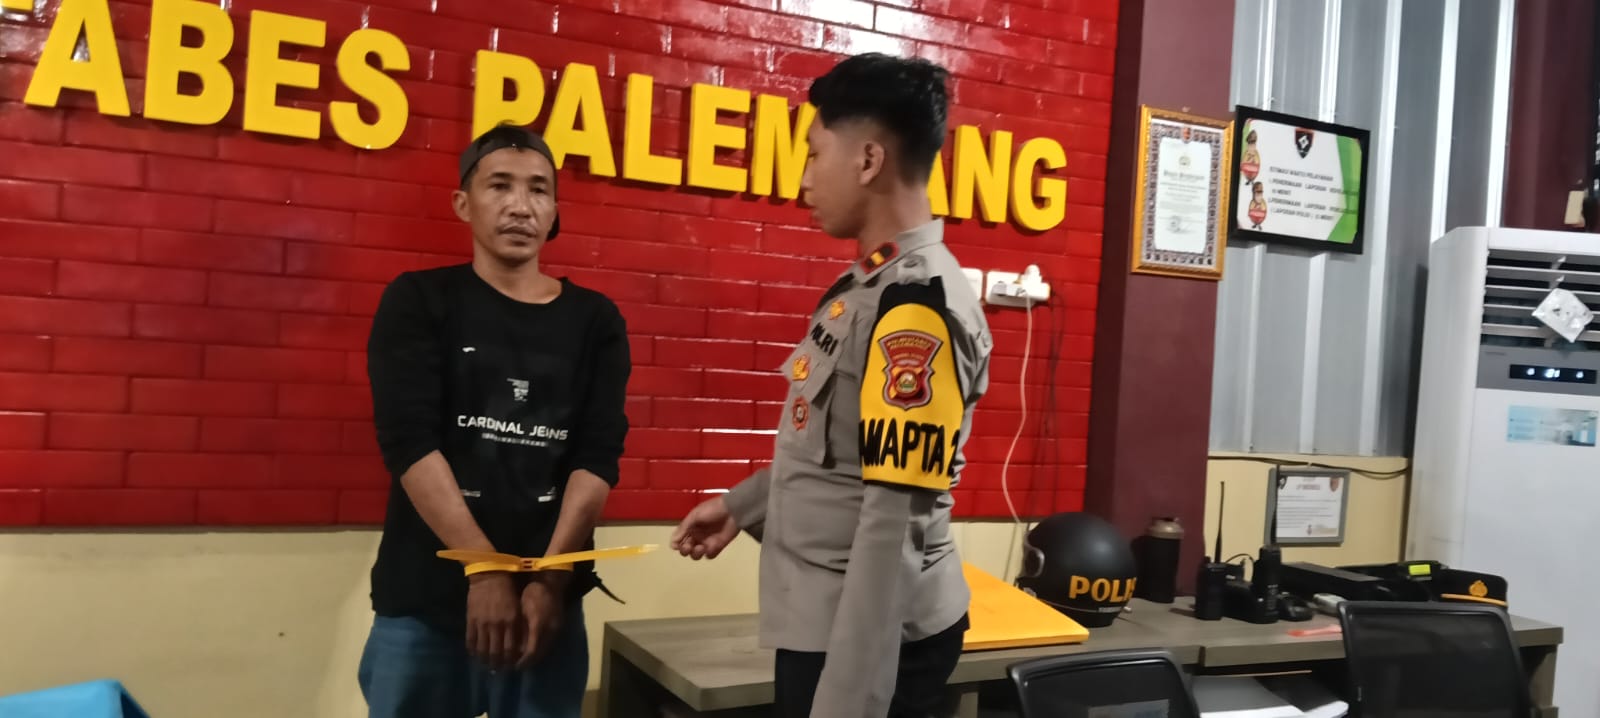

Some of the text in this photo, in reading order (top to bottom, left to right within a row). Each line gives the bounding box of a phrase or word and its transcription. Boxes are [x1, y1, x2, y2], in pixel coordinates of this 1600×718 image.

[0, 0, 1067, 231] ABES PALEMNG
[457, 415, 525, 435] CARDNAL
[529, 425, 569, 441] JENS
